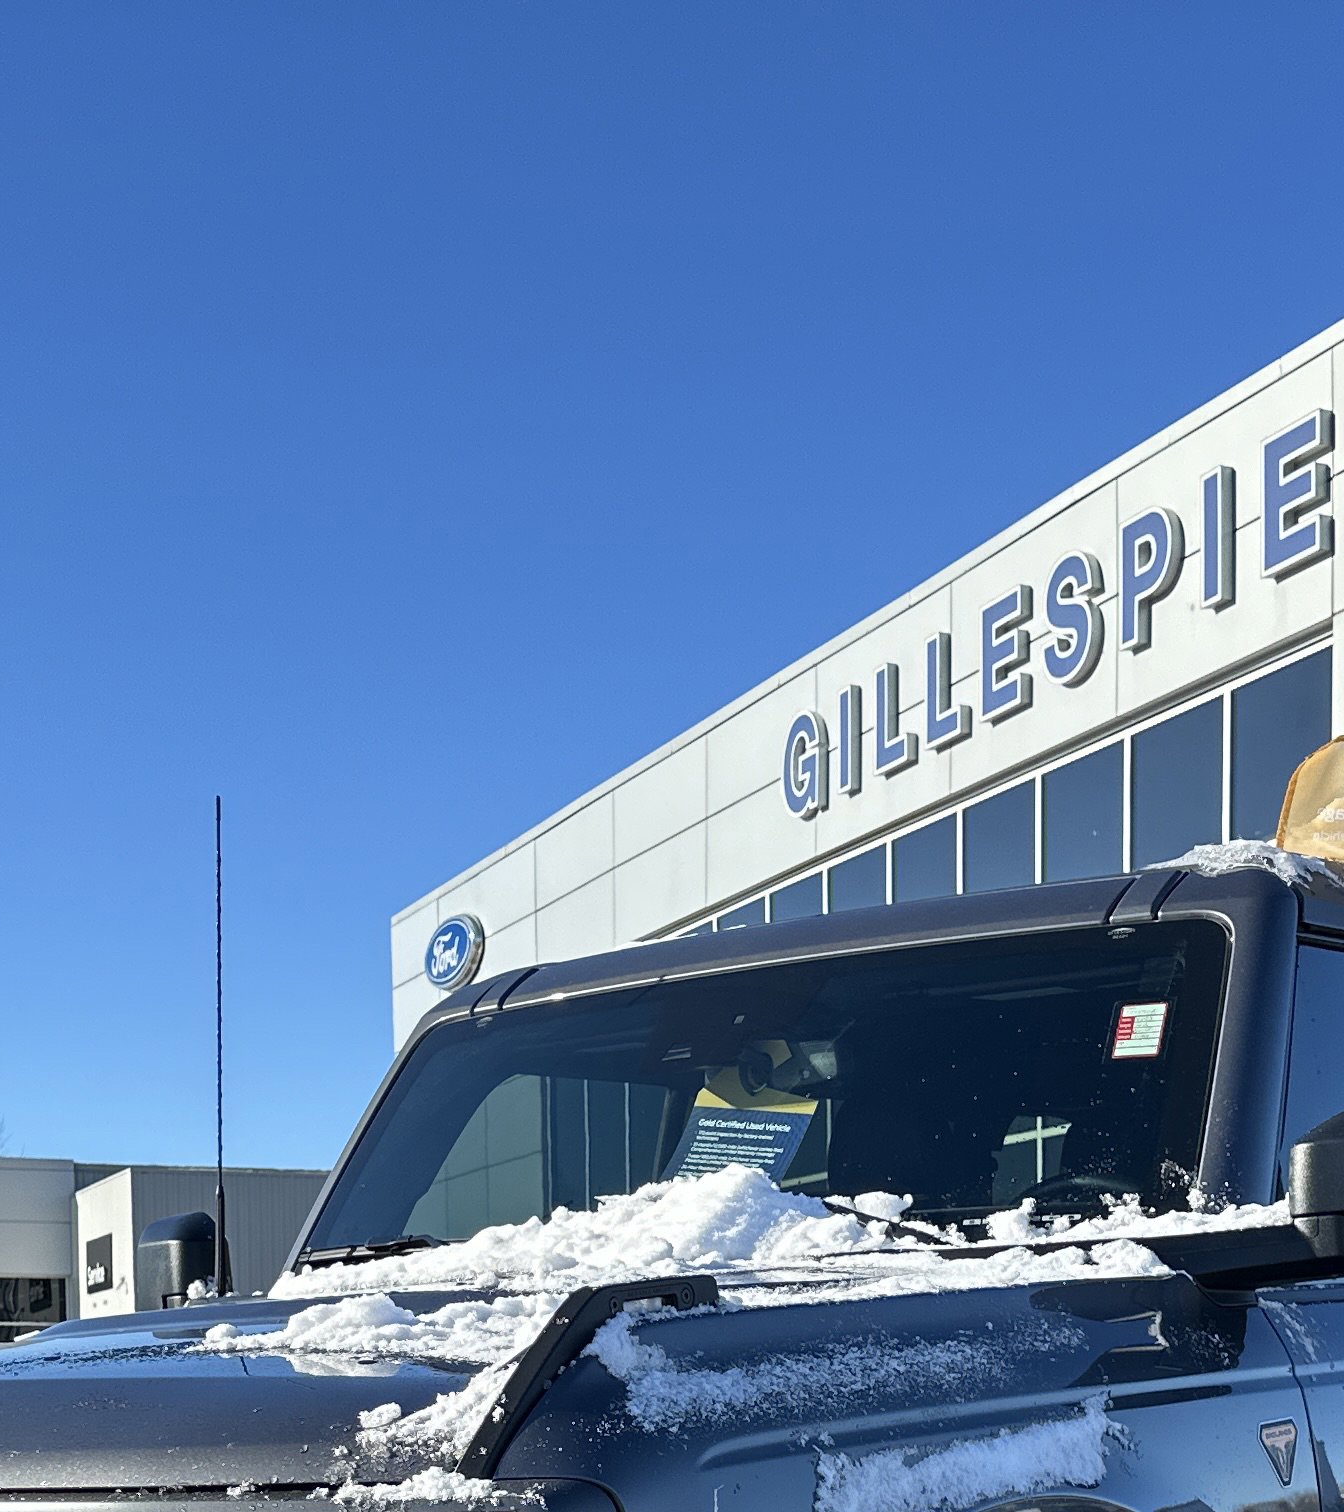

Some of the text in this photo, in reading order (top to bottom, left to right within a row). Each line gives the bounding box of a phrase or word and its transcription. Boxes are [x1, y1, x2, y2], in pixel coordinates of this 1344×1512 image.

[781, 408, 1335, 820] GILLESPIE
[431, 931, 459, 977] Ford
[698, 1118, 715, 1128] Gold
[716, 1119, 746, 1129] Certified
[766, 1122, 791, 1132] Vehicle
